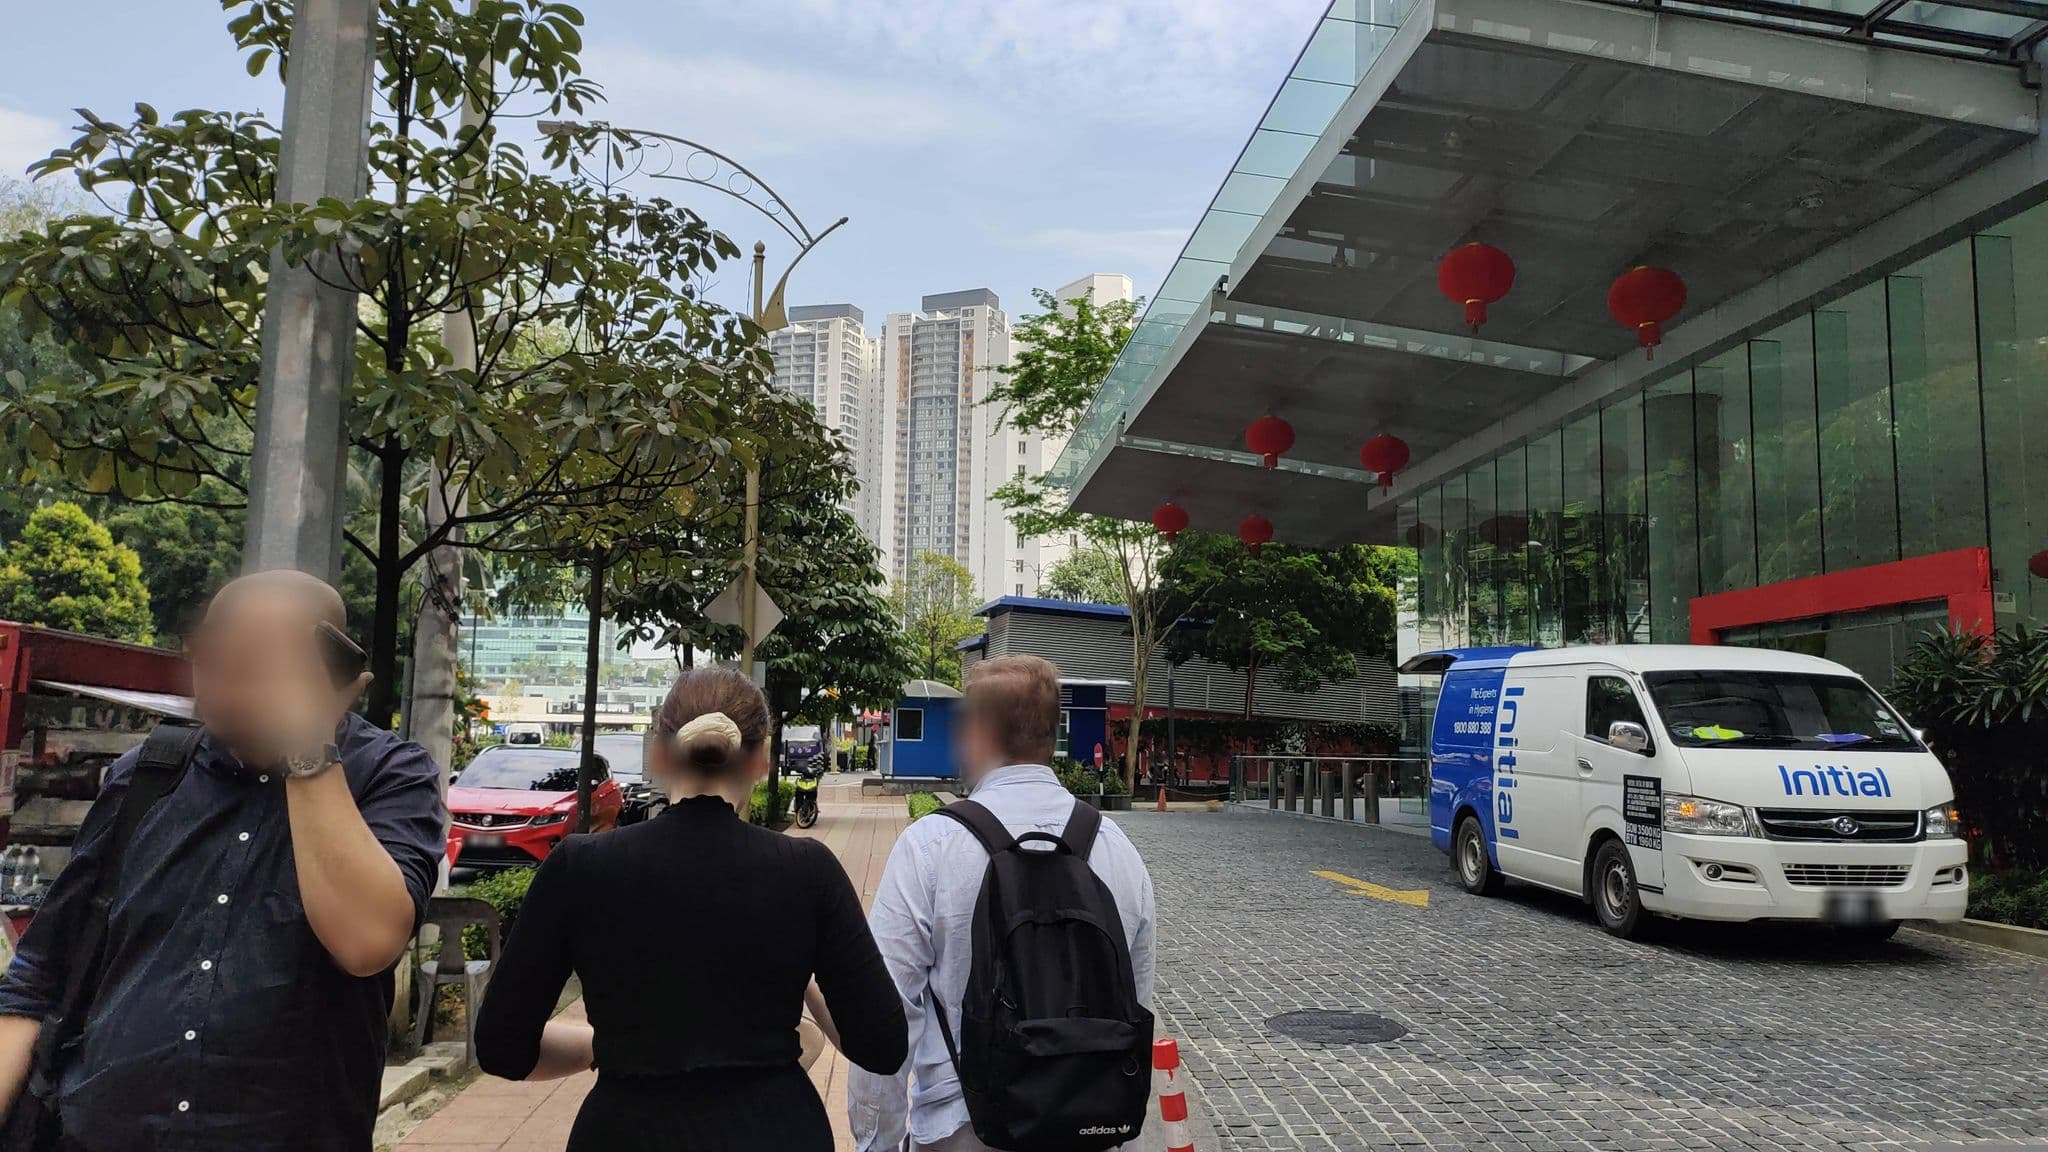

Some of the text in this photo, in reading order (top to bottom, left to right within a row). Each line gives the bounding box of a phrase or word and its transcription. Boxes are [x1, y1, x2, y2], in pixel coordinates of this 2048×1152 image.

[1478, 688, 1497, 701] Experts
[1468, 704, 1494, 717] in Hygiene
[1454, 722, 1492, 735] 1800 880 388
[1498, 687, 1525, 839] Initial
[1778, 764, 1891, 798] Initial
[1638, 824, 1653, 837] 3500
[1653, 827, 1661, 838] KG
[1653, 838, 1661, 850] KG
[1079, 1126, 1116, 1135] adidas
